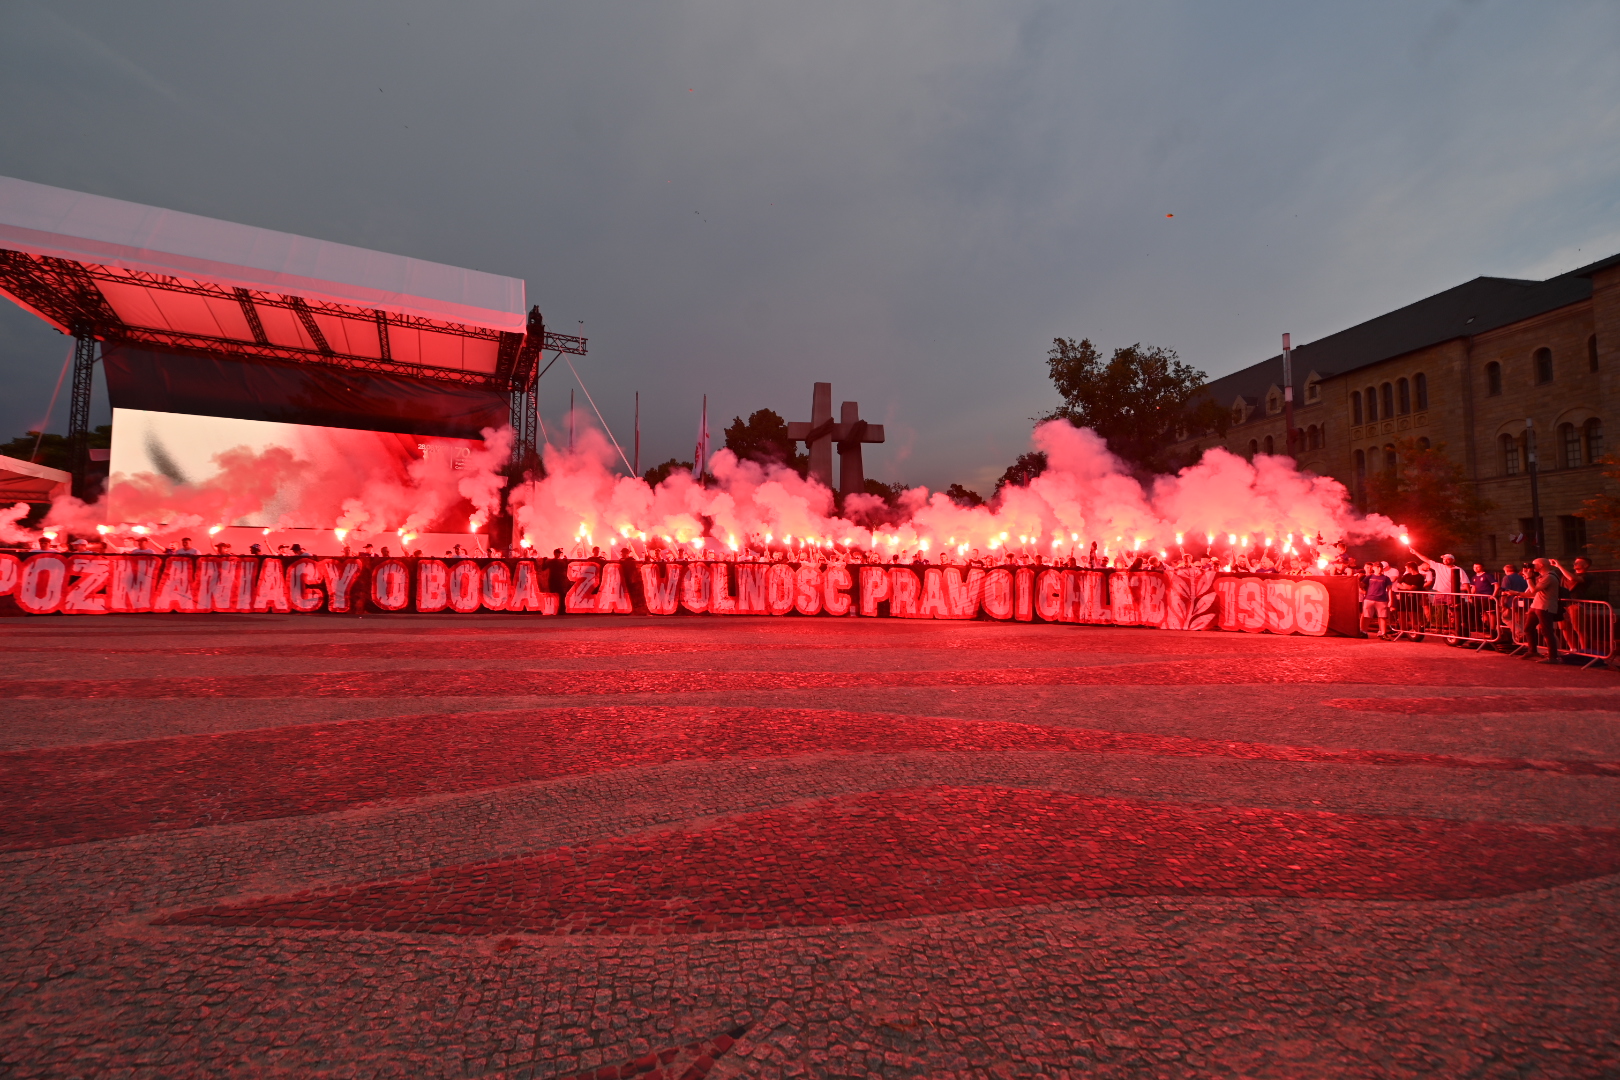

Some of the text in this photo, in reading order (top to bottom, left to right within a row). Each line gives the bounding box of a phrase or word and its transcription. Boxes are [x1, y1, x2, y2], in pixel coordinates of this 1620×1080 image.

[374, 561, 408, 609] O
[418, 561, 557, 614] BOGA,
[567, 563, 630, 611] ZA
[861, 568, 1012, 618] PRAWO
[1017, 570, 1031, 618] I
[1216, 579, 1327, 634] 1956
